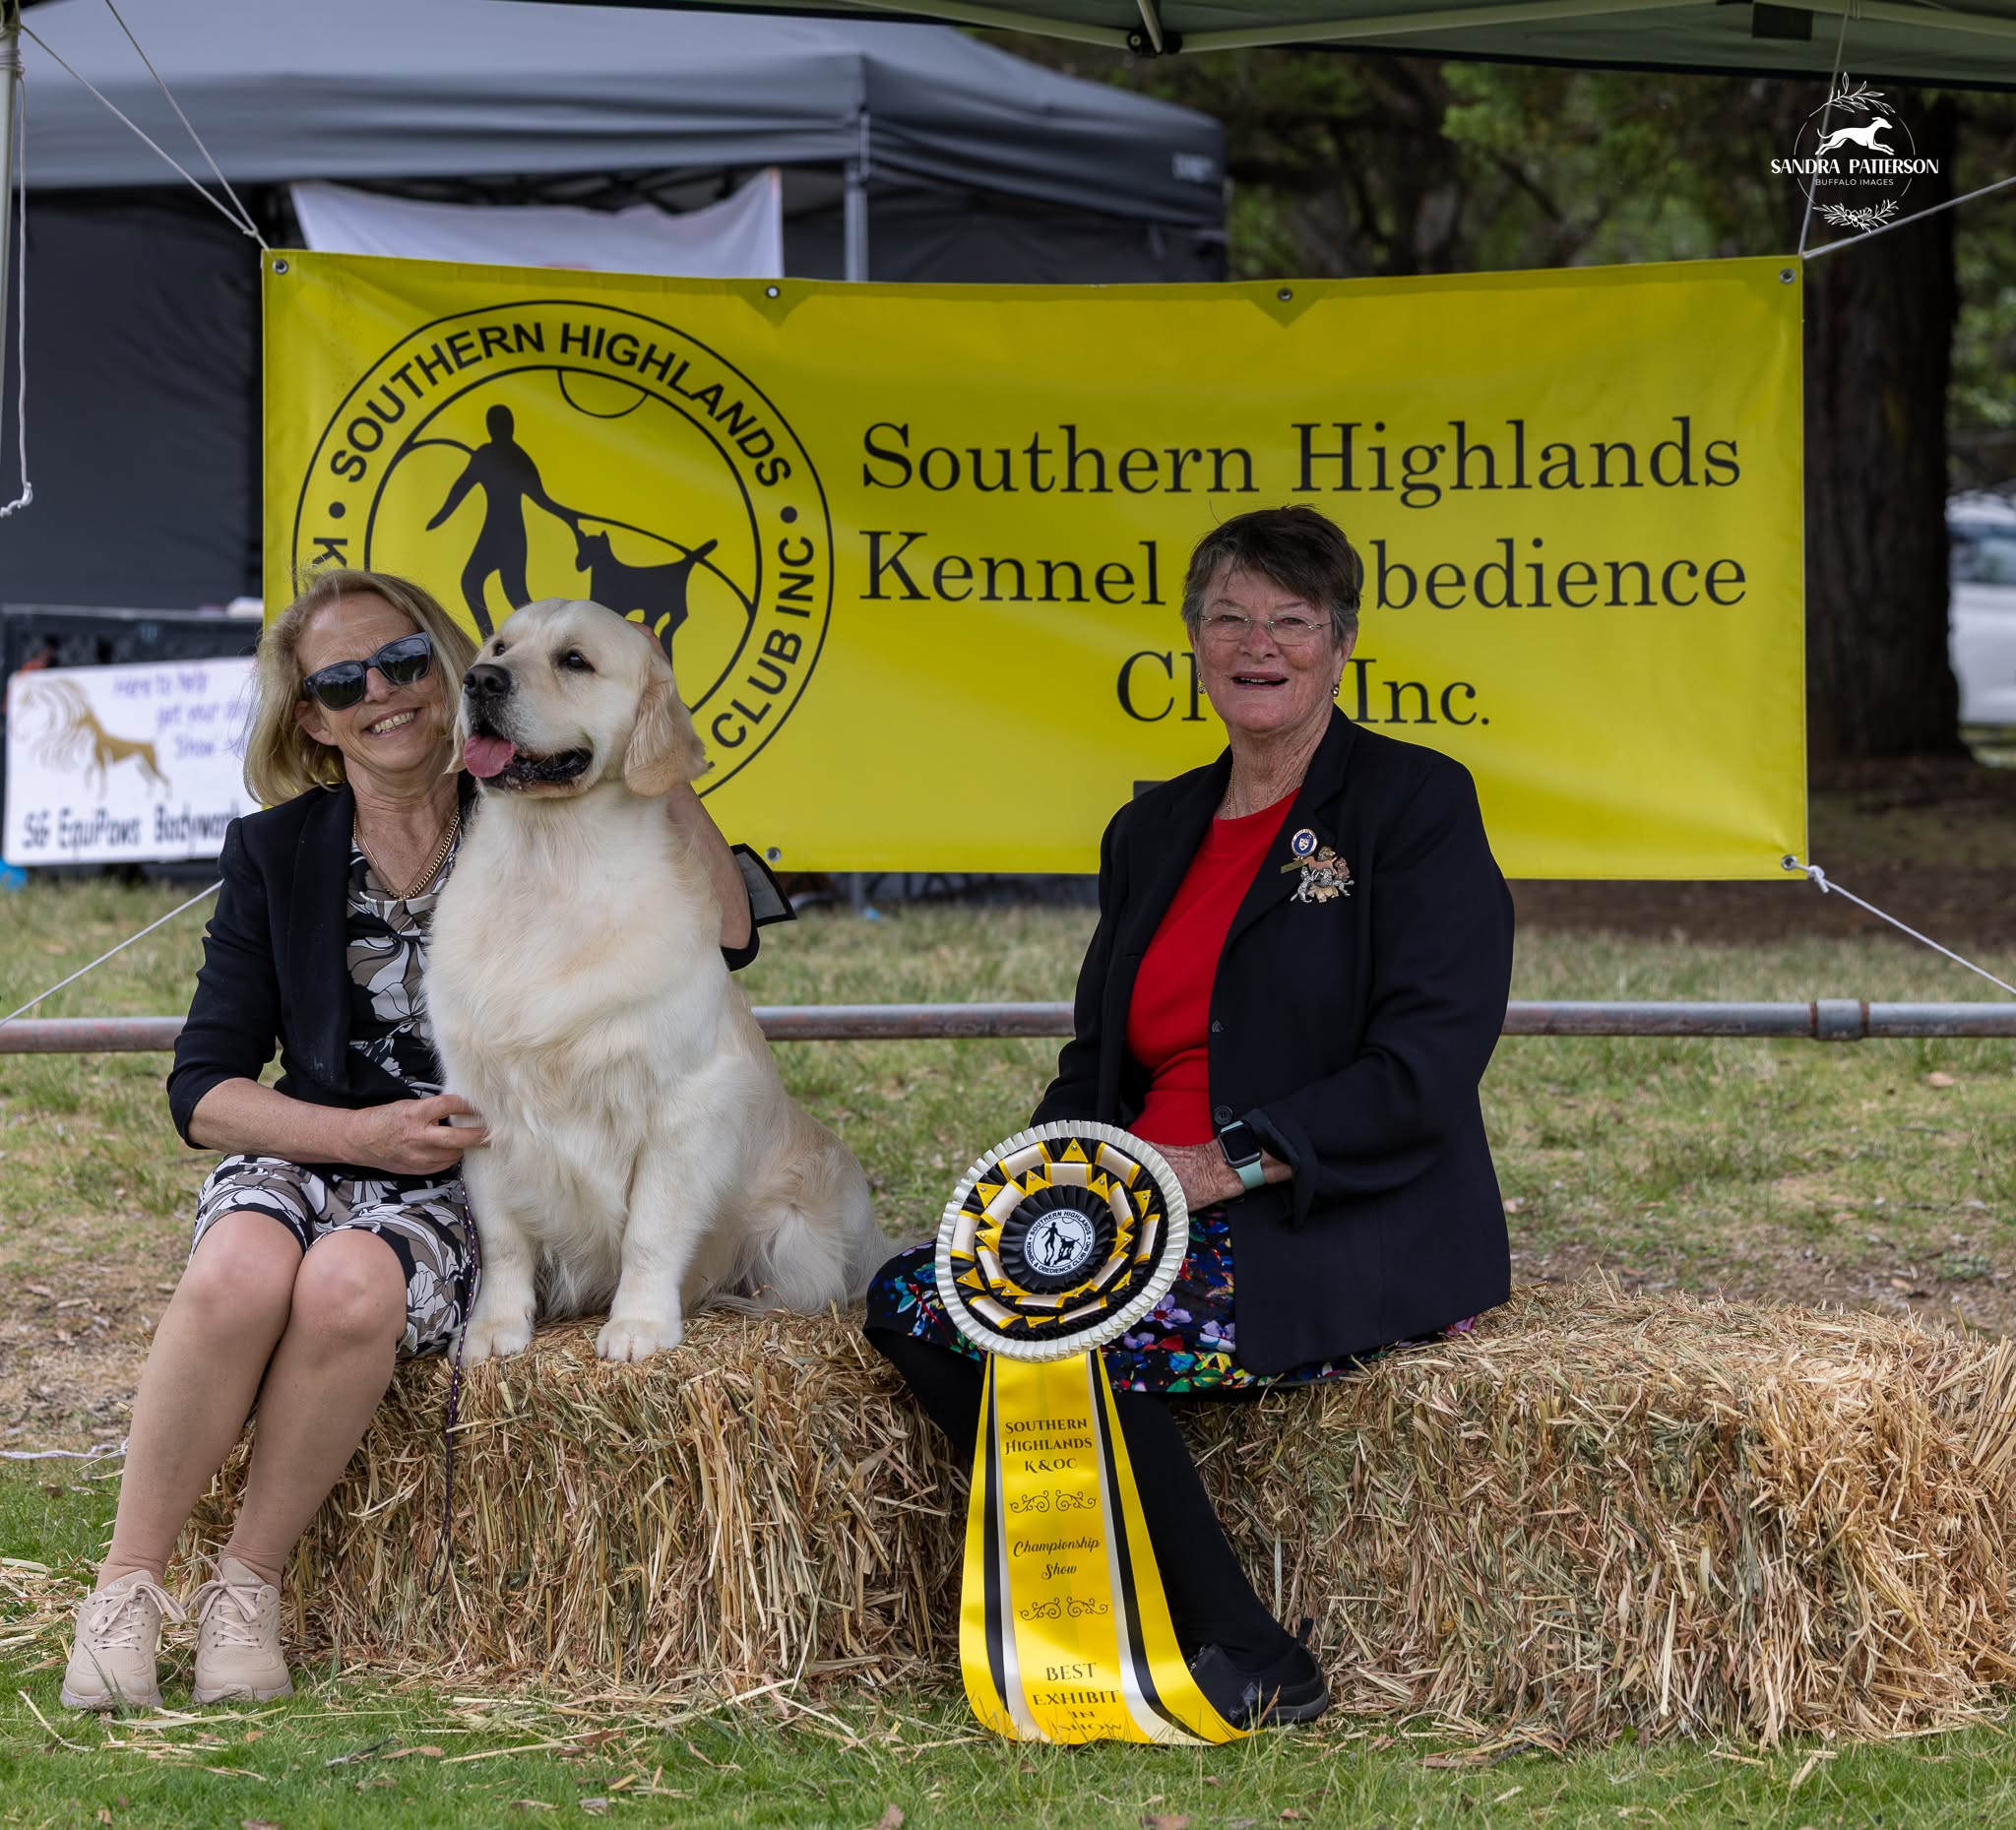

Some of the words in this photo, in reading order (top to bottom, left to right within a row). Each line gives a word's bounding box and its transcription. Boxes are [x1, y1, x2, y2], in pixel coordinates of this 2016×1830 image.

[330, 322, 545, 482] SOUTHERN
[560, 322, 791, 487] HIGHLANDS
[862, 421, 1259, 494] Southern
[1291, 415, 1740, 509] Highlands
[858, 530, 1166, 605] Kennel
[1352, 536, 1747, 609] bedience
[711, 629, 802, 748] CLUB
[775, 536, 814, 618] INC
[1116, 651, 1207, 723] Cl
[1348, 658, 1489, 726] Inc.
[1030, 1211, 1062, 1236] SOUTHERN
[1063, 1211, 1092, 1235] HIGHLANDS
[1026, 1241, 1036, 1265] KENNEL
[1038, 1265, 1072, 1274] OBEDIENCE
[1072, 1252, 1087, 1267] CLUB
[1005, 1418, 1088, 1434] SOUTHERN
[1005, 1437, 1093, 1455] HIGHLANDS
[1025, 1457, 1078, 1474] K&OC
[1013, 1537, 1101, 1557] Championship
[1040, 1562, 1077, 1580] Show
[1045, 1662, 1097, 1681] BEST
[1033, 1690, 1119, 1705] EXHIBIT
